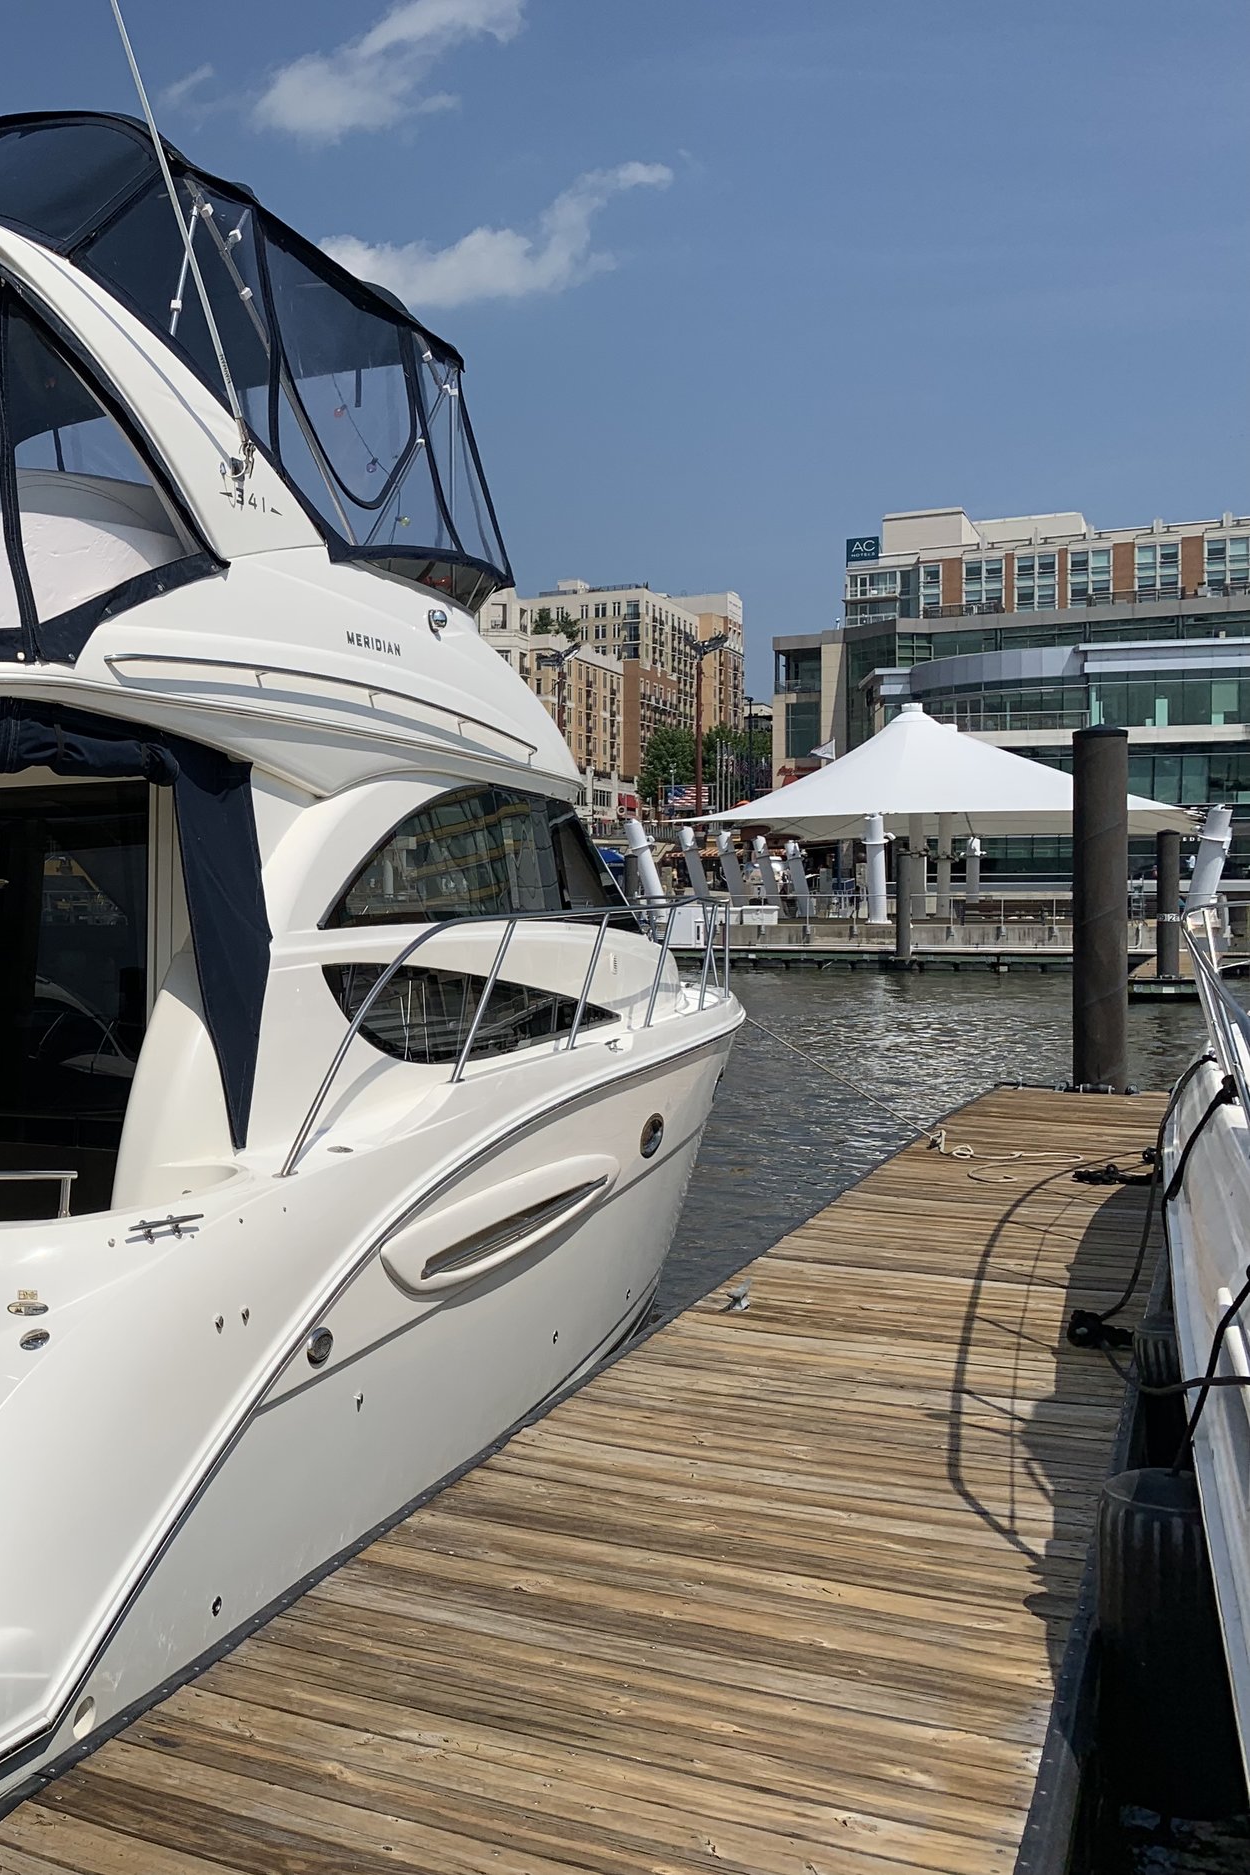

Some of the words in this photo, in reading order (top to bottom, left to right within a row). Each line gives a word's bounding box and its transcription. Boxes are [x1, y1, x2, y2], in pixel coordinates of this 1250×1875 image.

[235, 487, 266, 513] 341
[851, 539, 876, 553] AC
[346, 630, 402, 657] MERIDIAN
